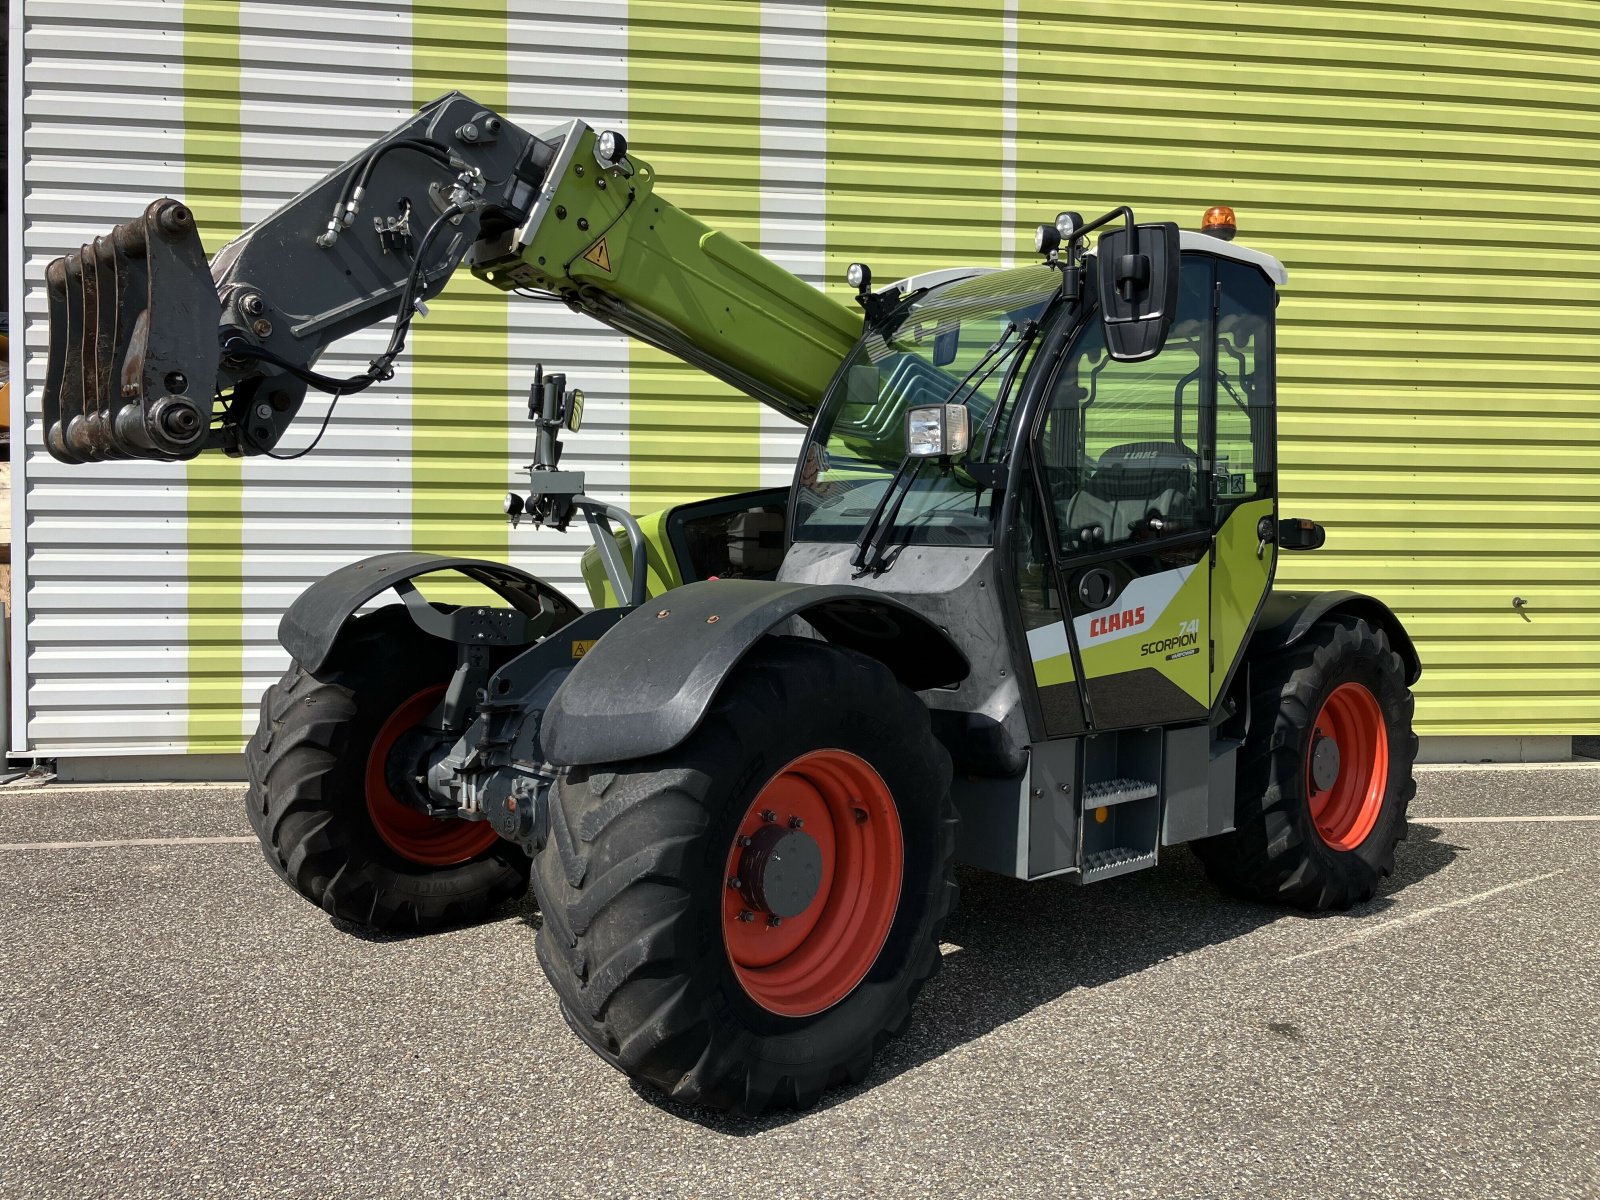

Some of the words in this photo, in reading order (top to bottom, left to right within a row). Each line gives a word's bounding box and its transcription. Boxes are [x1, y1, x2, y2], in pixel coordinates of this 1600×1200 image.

[1090, 606, 1145, 638] CLAAS
[1179, 618, 1200, 637] 741
[1141, 632, 1197, 656] SCORPION
